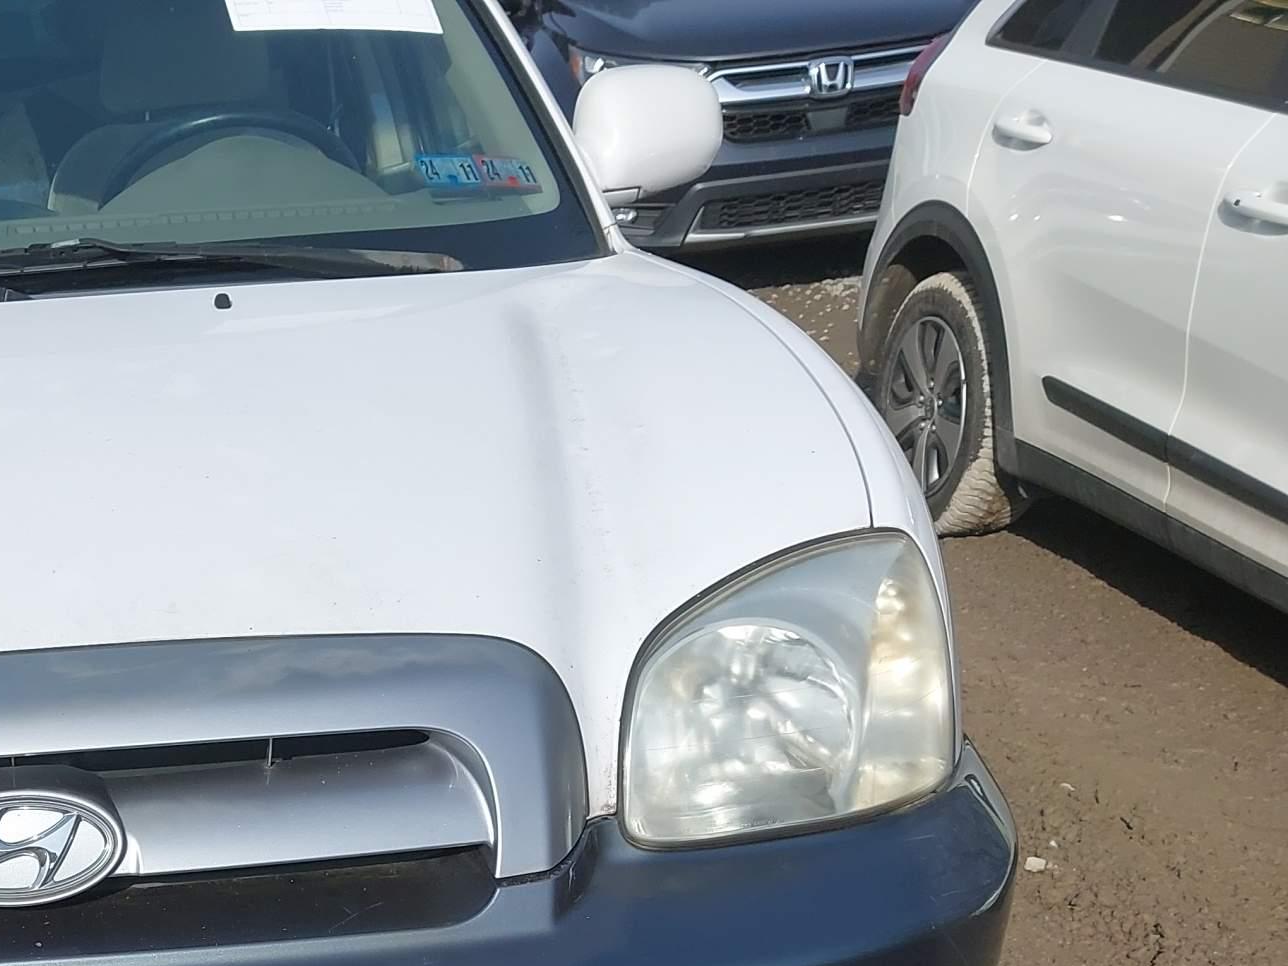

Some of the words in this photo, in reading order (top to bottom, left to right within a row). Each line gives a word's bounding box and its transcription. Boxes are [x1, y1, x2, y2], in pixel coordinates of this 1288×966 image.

[420, 159, 441, 180] 24
[459, 161, 479, 181] 11
[482, 159, 503, 180] 24
[517, 164, 537, 183] 11
